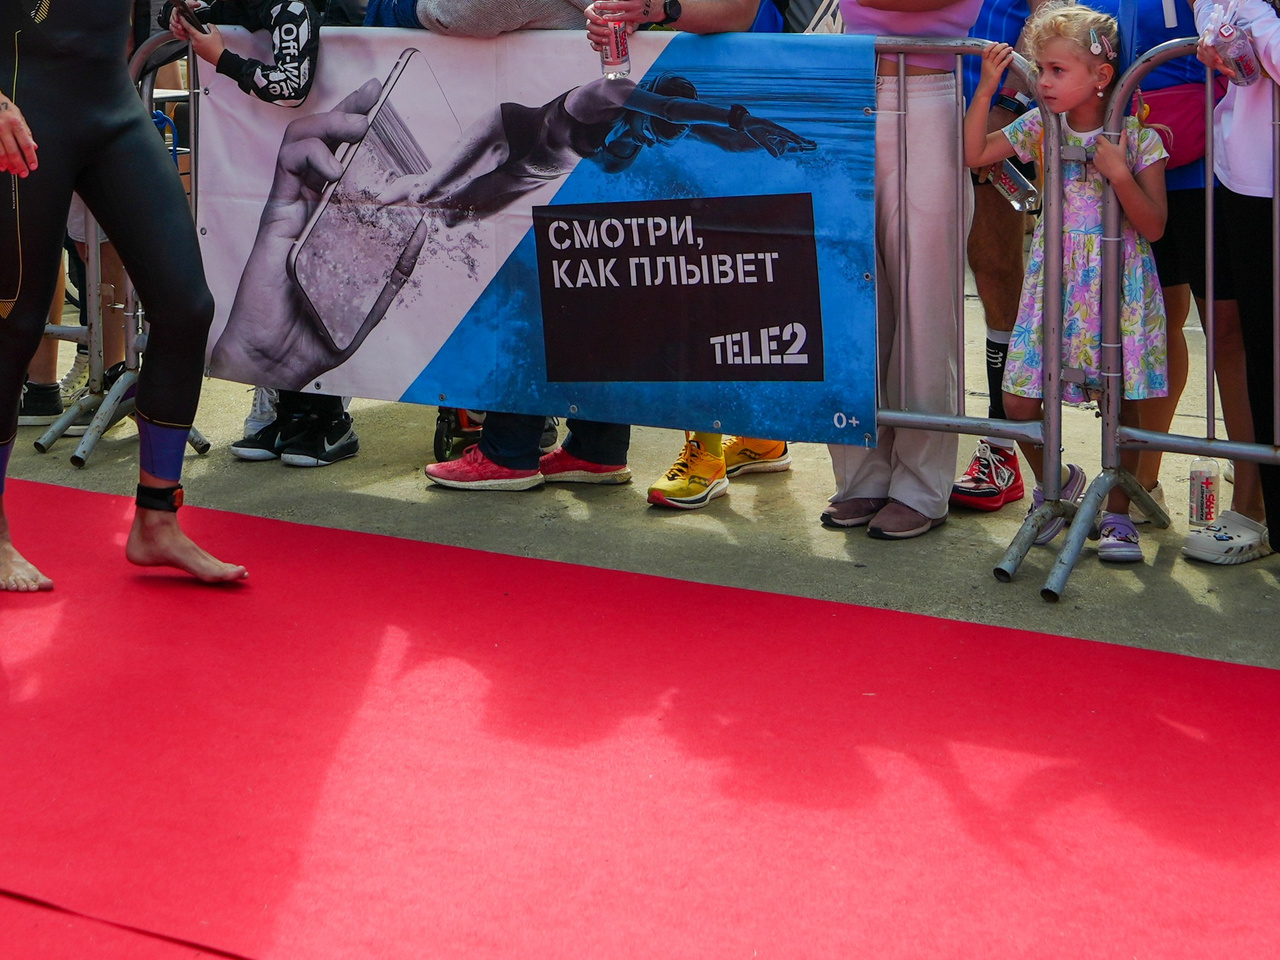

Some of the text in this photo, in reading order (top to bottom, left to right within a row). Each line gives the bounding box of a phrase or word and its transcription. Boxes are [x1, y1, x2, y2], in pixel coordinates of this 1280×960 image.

[548, 215, 704, 250] СМОТРИ,
[551, 252, 779, 288] КАК ПЛЫВЕТ
[710, 322, 809, 365] TELE2
[833, 412, 860, 429] 0+
